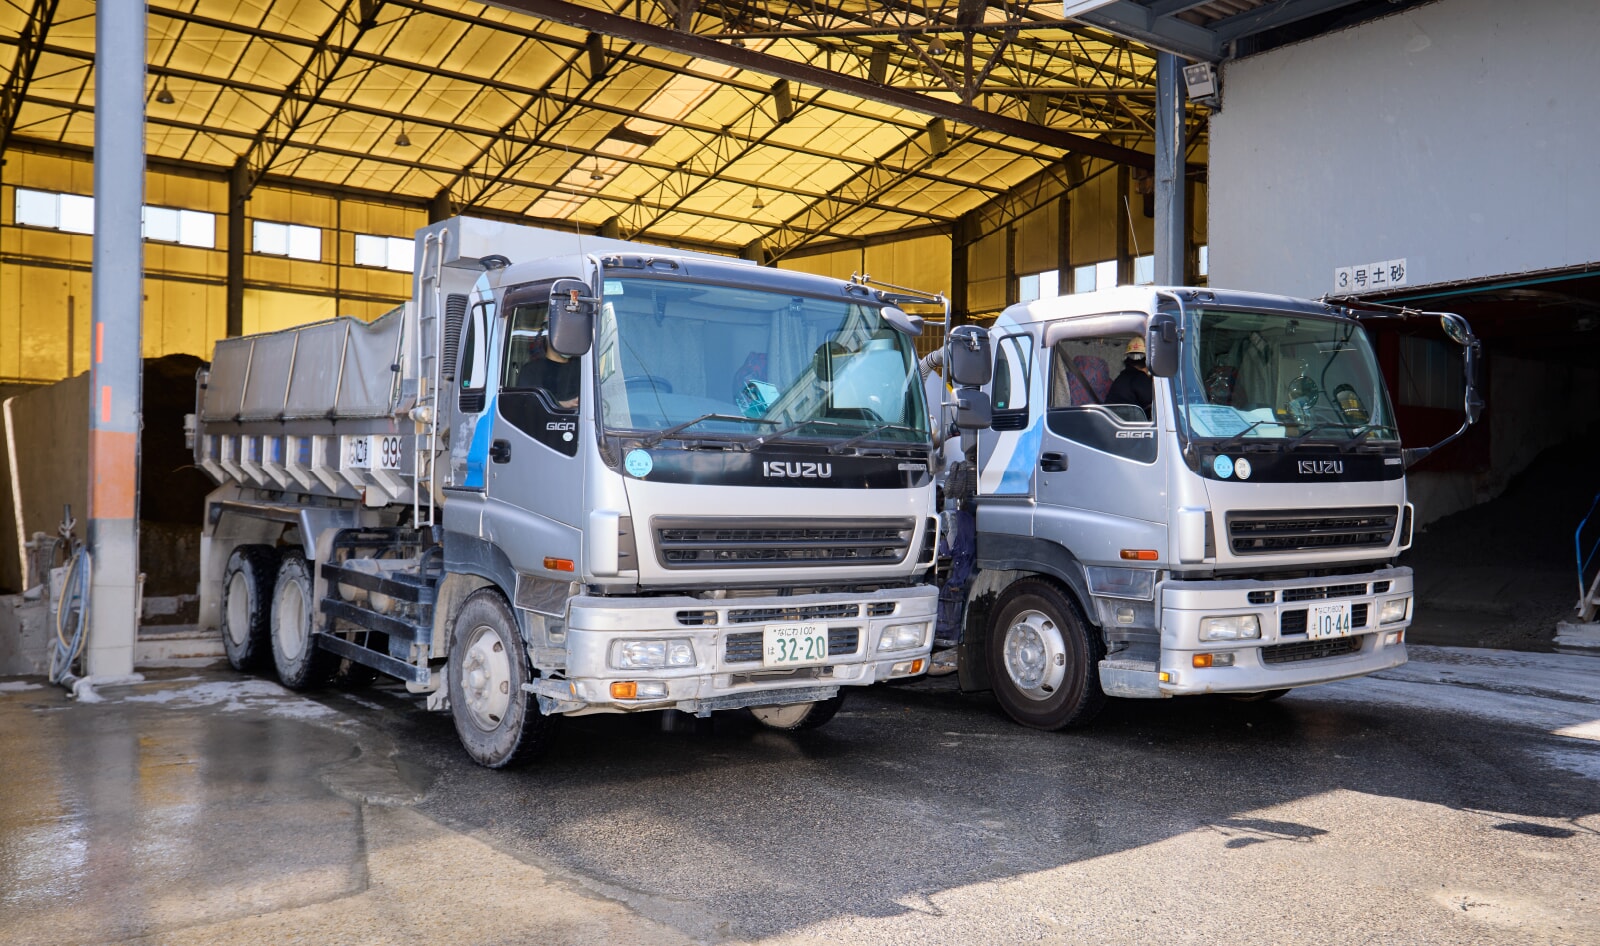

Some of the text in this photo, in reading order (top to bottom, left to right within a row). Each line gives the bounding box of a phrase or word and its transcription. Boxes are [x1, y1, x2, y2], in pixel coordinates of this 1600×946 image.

[1339, 263, 1405, 288] 3号土砂
[546, 422, 576, 431] GIGA
[1115, 430, 1154, 439] GIGA
[763, 461, 832, 478] ISUZU
[1297, 460, 1344, 474] ISUZU
[776, 635, 826, 662] 32-20
